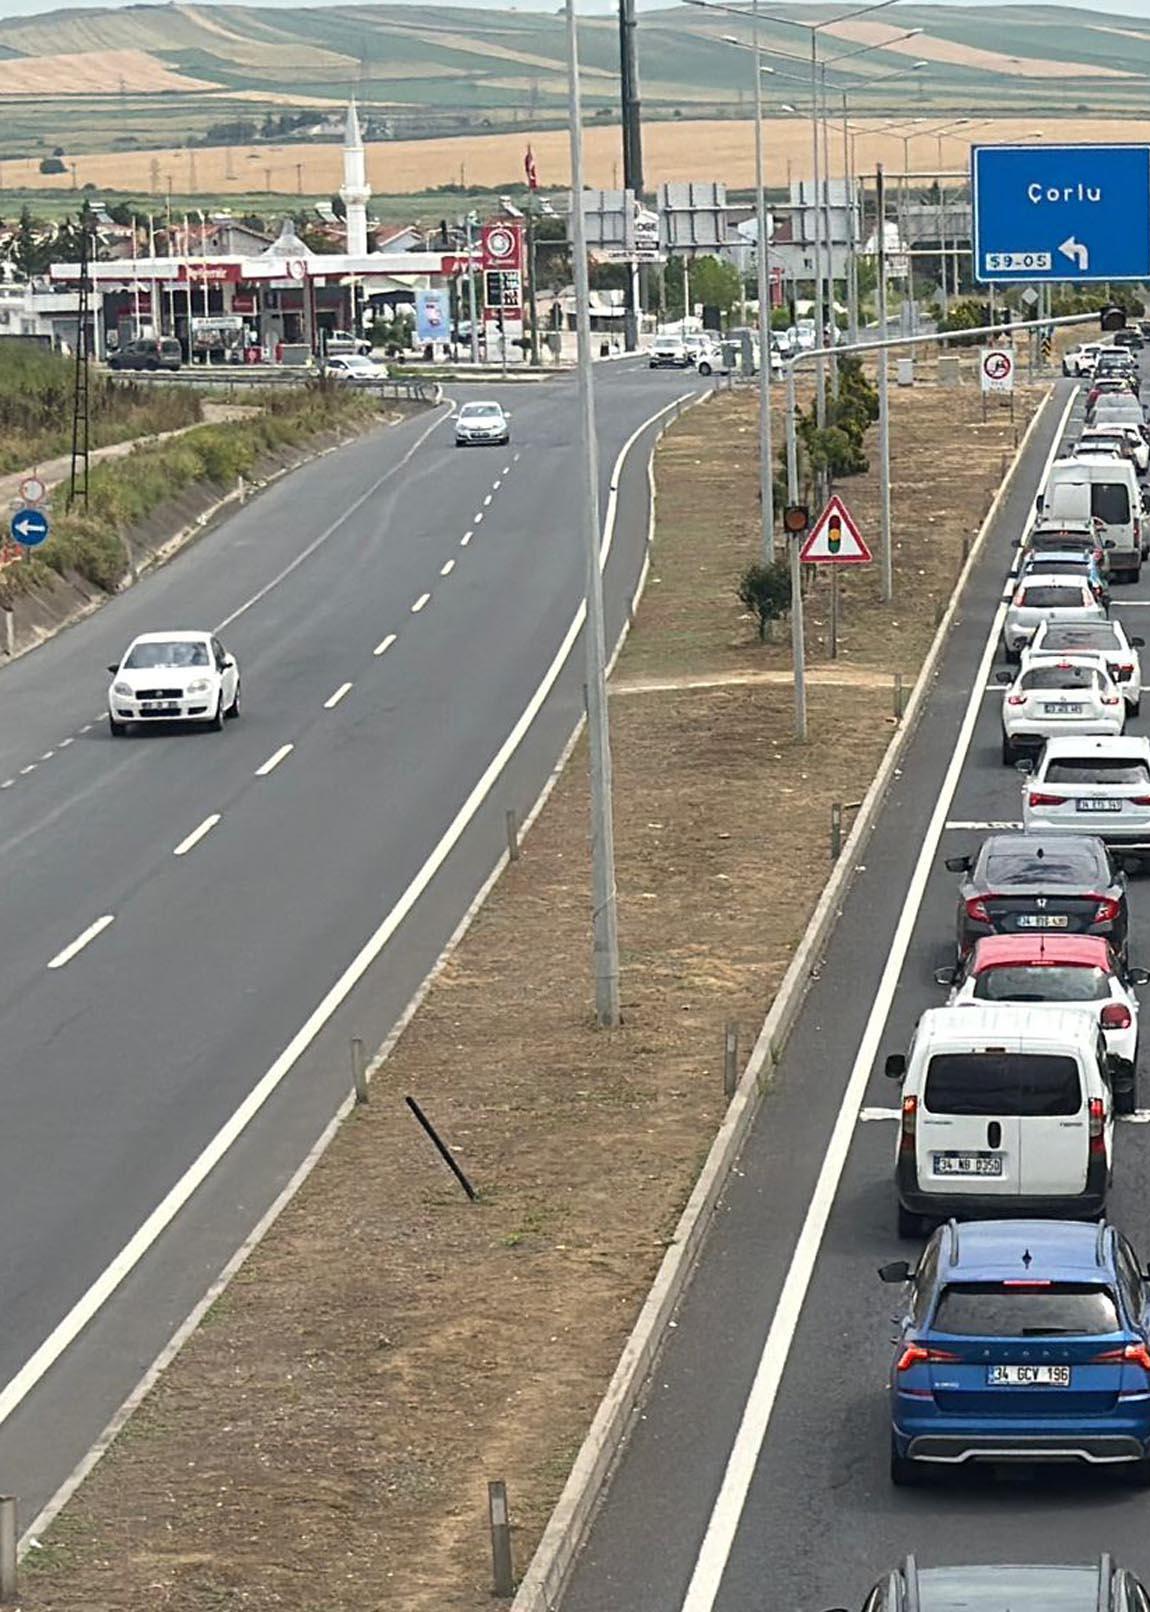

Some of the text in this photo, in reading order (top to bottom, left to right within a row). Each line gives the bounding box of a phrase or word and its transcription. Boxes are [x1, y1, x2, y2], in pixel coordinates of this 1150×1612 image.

[1028, 183, 1101, 203] Çorlu
[990, 255, 1047, 268] 59-05
[941, 1159, 952, 1170] 34
[994, 1367, 1068, 1381] 34 GCV 196
